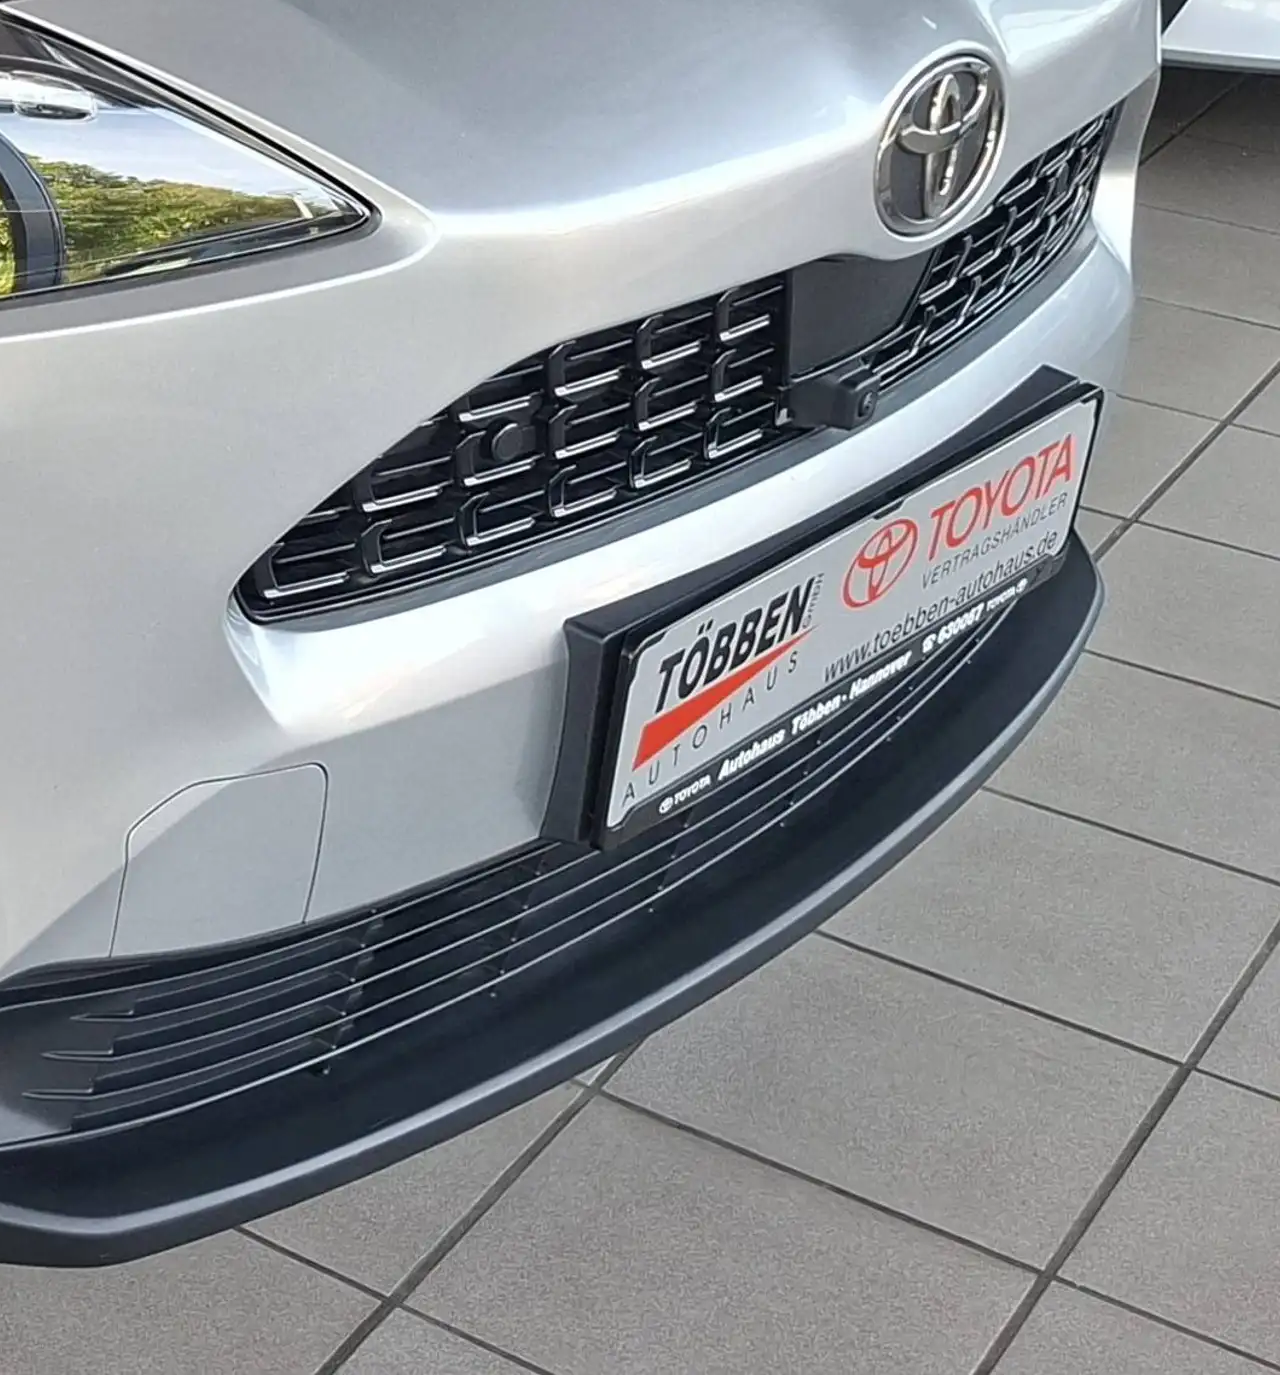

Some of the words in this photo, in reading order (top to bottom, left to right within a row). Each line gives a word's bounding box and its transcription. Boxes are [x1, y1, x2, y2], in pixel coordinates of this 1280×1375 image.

[922, 492, 1067, 588] VERTRAGSHÄNDLER
[928, 433, 1074, 561] TOYOTA
[655, 576, 816, 714] TÖBBEN
[824, 530, 1058, 683] www.toebben-autohaus.de
[674, 775, 711, 804] TOYOTA
[718, 729, 785, 780] Autohaus
[849, 651, 912, 699] Hannover
